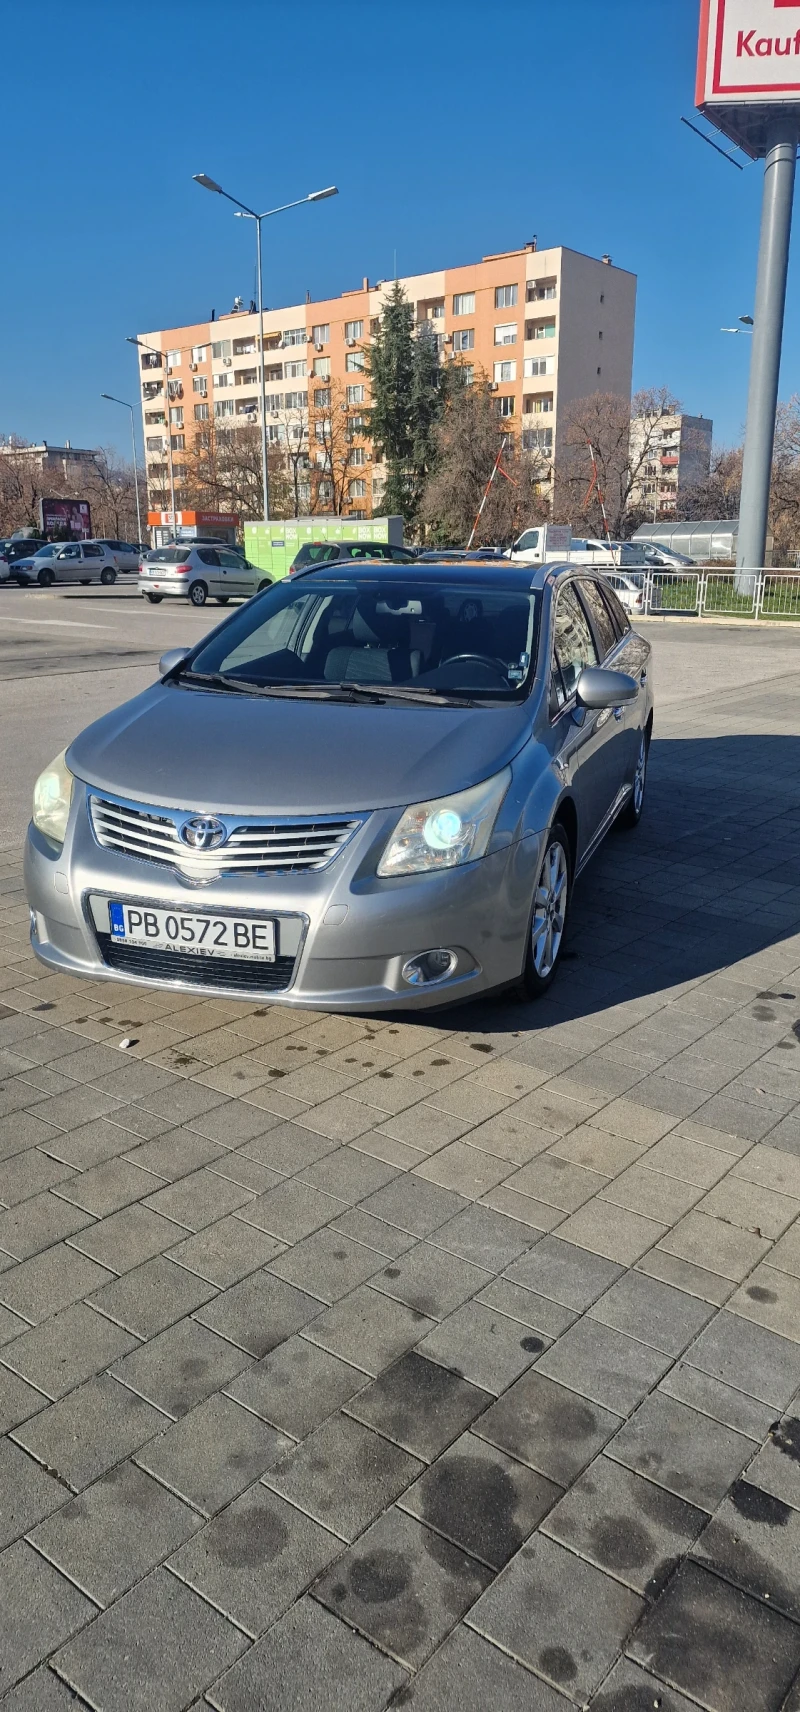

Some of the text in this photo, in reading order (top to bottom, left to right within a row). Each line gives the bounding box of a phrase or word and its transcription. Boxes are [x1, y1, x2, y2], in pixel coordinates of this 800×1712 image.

[114, 924, 124, 932] BG
[128, 910, 269, 950] PB 0572 BE
[165, 944, 215, 956] ALEXIEV
